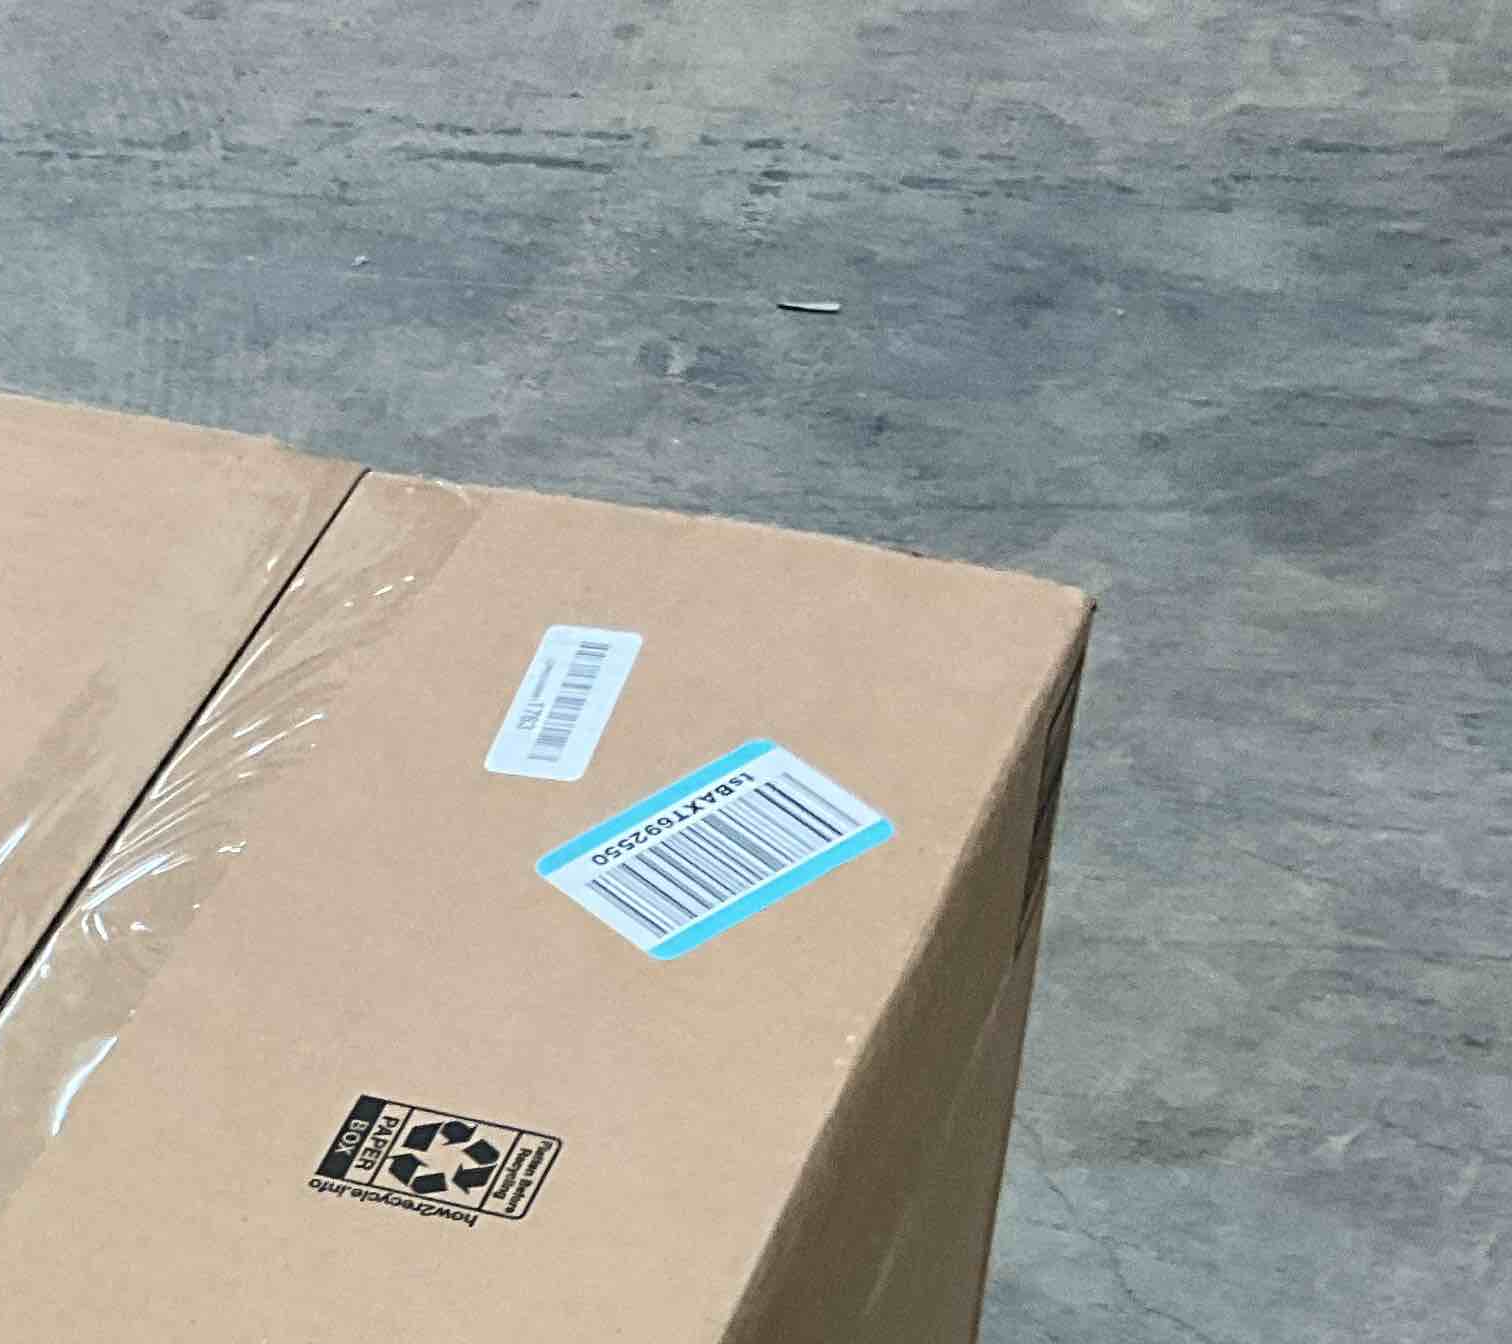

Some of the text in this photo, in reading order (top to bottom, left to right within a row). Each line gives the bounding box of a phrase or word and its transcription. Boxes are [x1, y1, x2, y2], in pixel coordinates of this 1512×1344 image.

[336, 1118, 370, 1156] BOX
[354, 1115, 400, 1172] PAPER
[492, 1147, 533, 1200] Recycling
[308, 1178, 479, 1228] how2recycle.info
